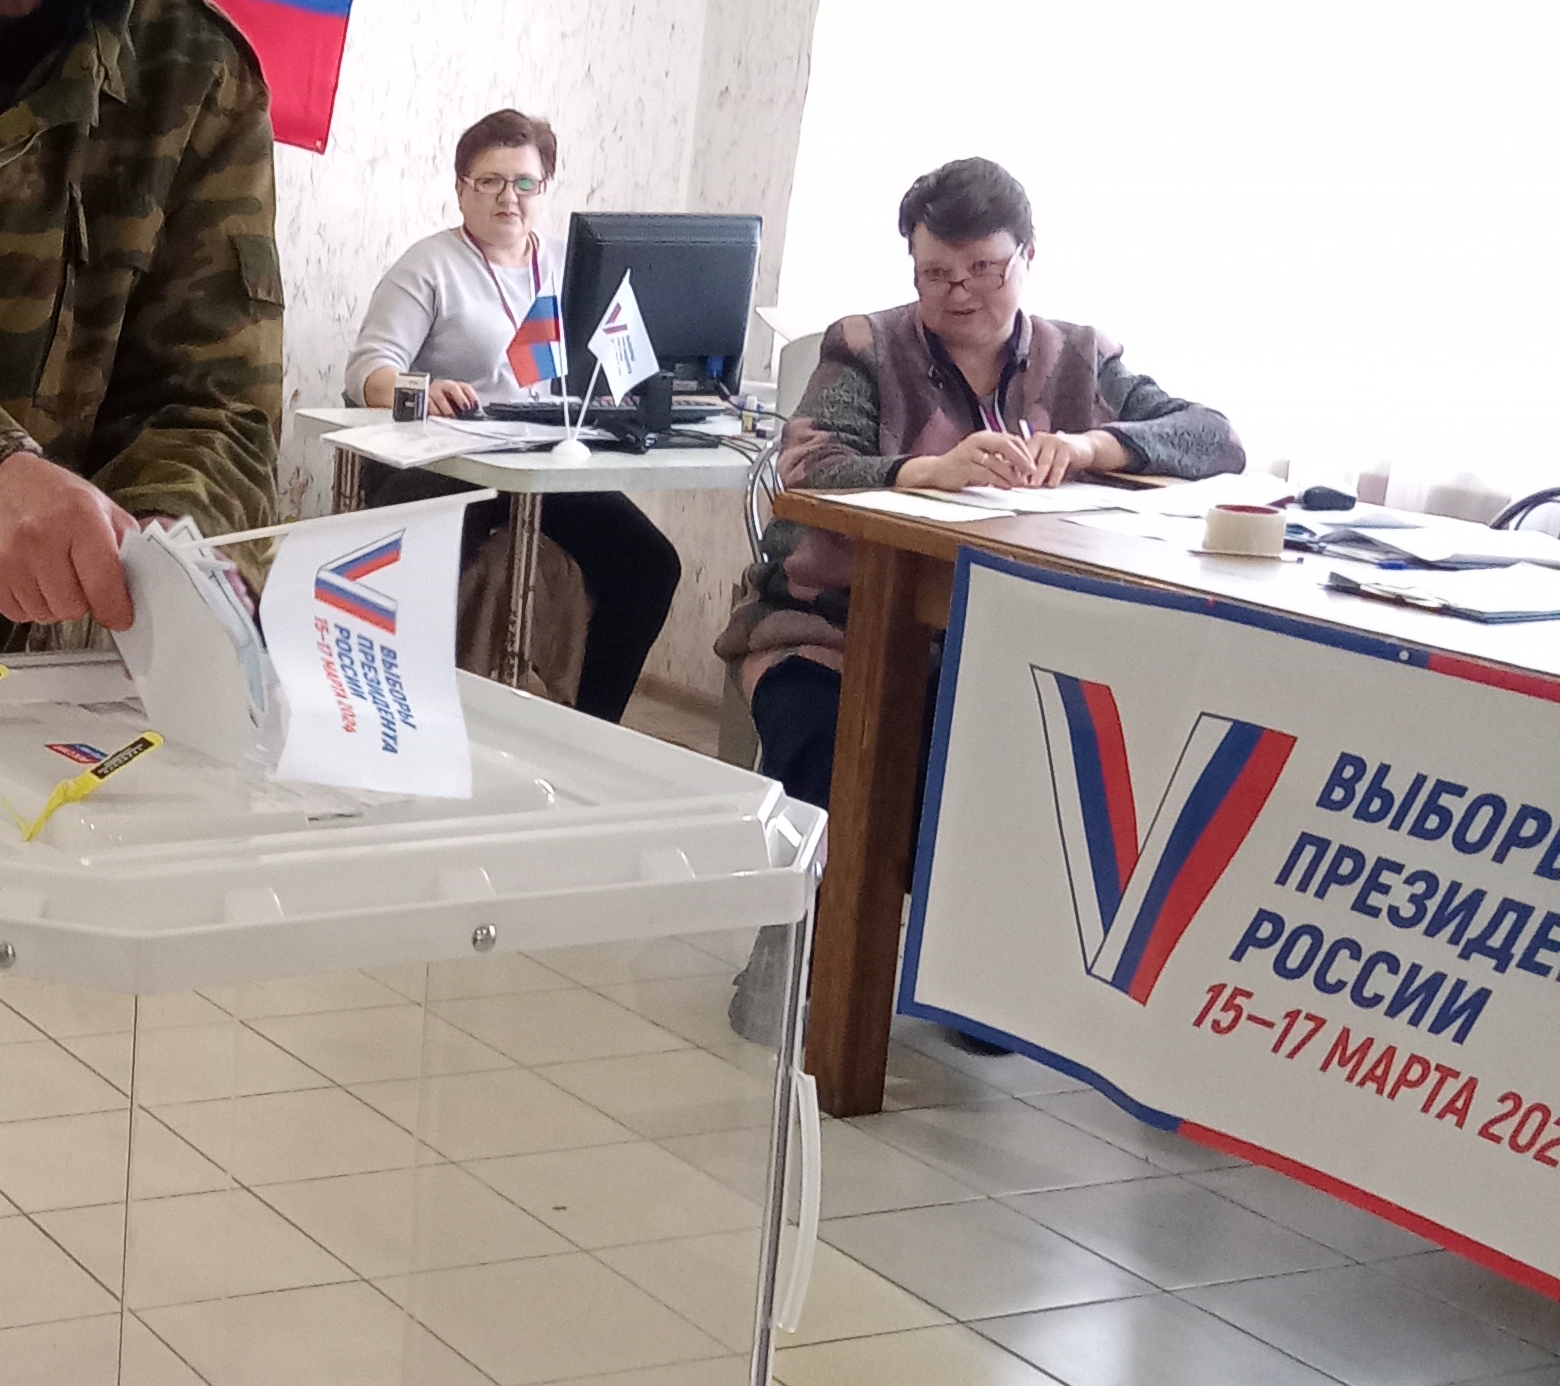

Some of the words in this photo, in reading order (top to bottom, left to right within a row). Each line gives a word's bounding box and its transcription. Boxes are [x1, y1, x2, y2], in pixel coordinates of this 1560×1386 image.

[334, 622, 367, 701] РОССИИ
[356, 632, 398, 754] ПРЕЗИДЕНТА
[380, 644, 417, 730] ВЫБОРЫ
[1274, 831, 1560, 982] ПРЕЗИДЕ
[1229, 907, 1493, 1045] РОССИИ
[1319, 1026, 1478, 1129] МАРТА
